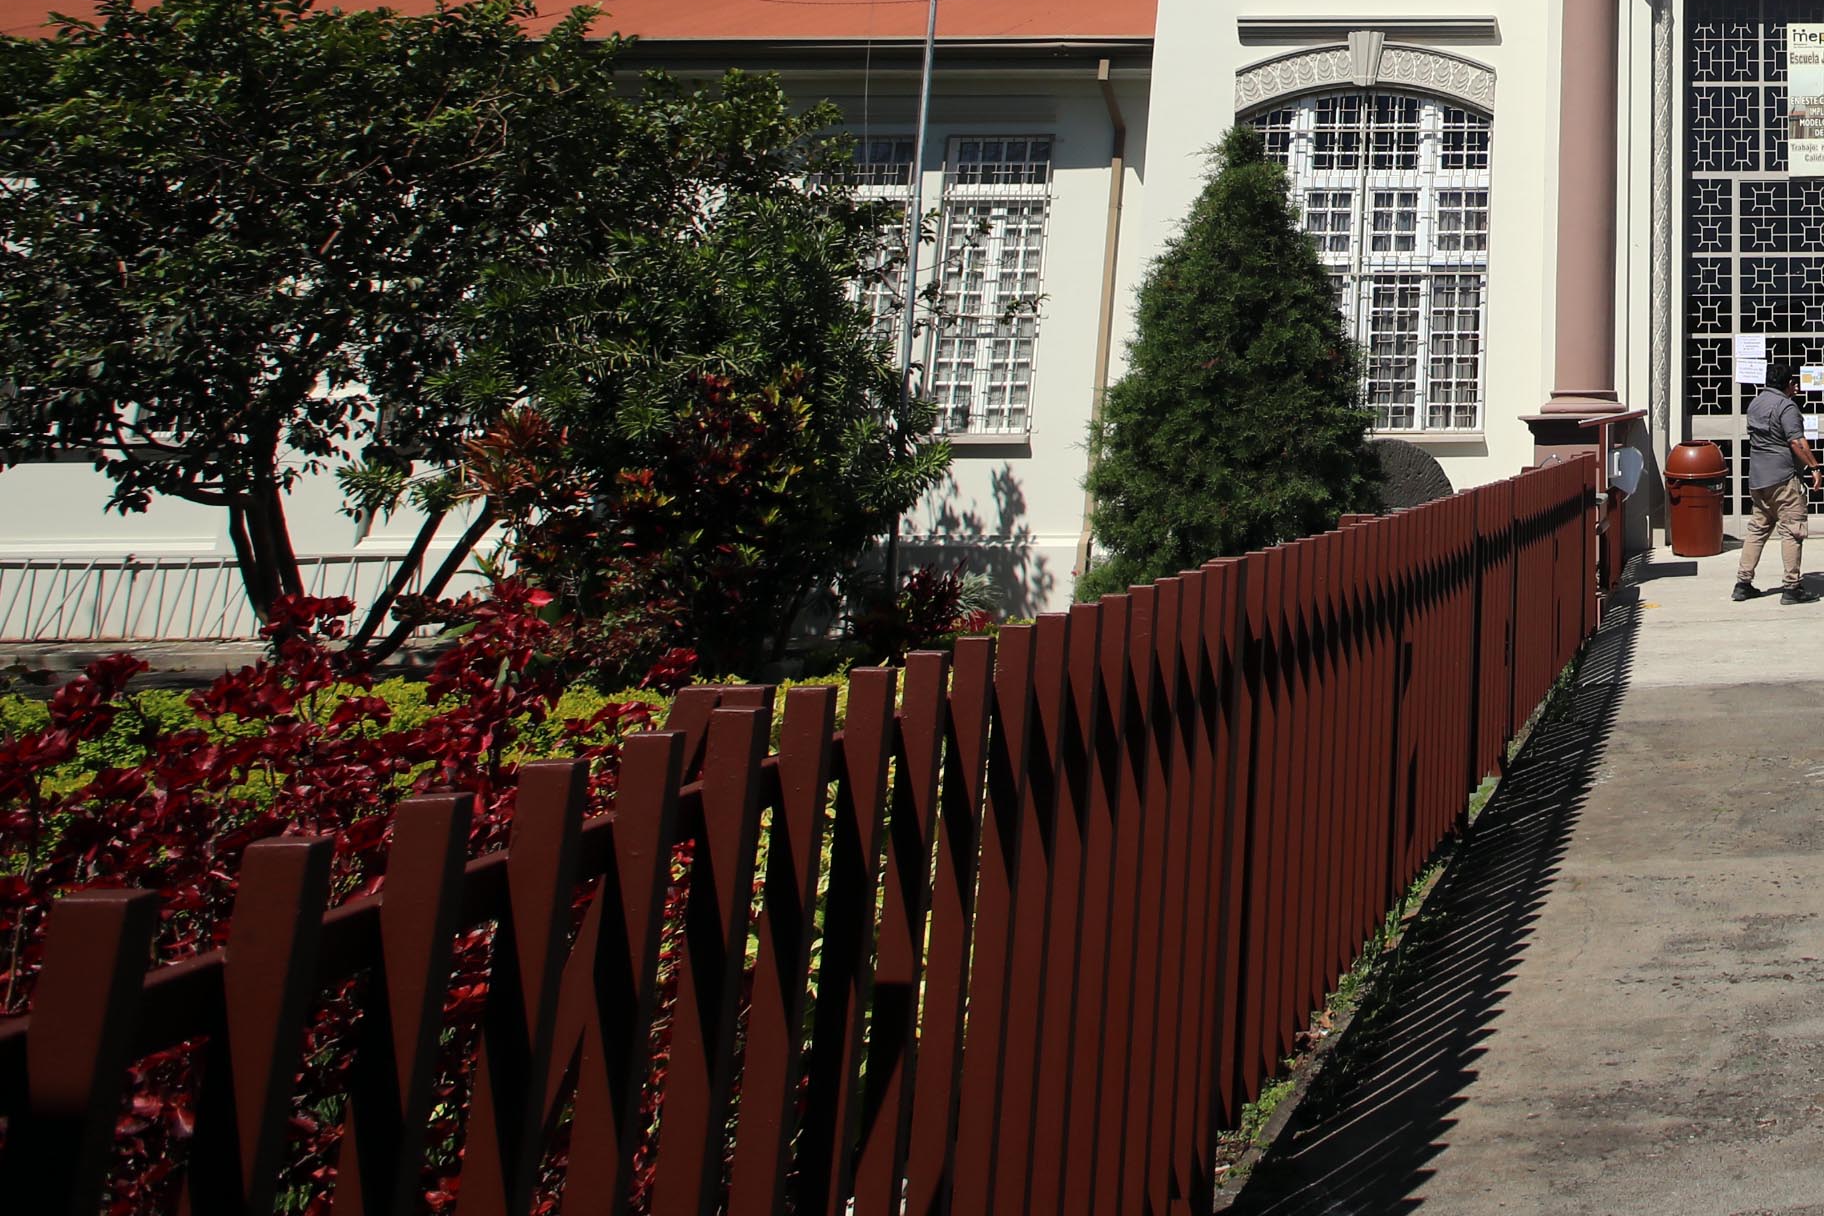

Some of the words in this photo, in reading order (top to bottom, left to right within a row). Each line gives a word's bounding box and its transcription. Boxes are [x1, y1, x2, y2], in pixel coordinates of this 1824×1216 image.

[1789, 51, 1819, 64] Escuela
[1790, 96, 1800, 104] EN
[1802, 96, 1818, 104] ESTE
[1814, 128, 1824, 136] DE
[1791, 143, 1819, 152] Trabajo:
